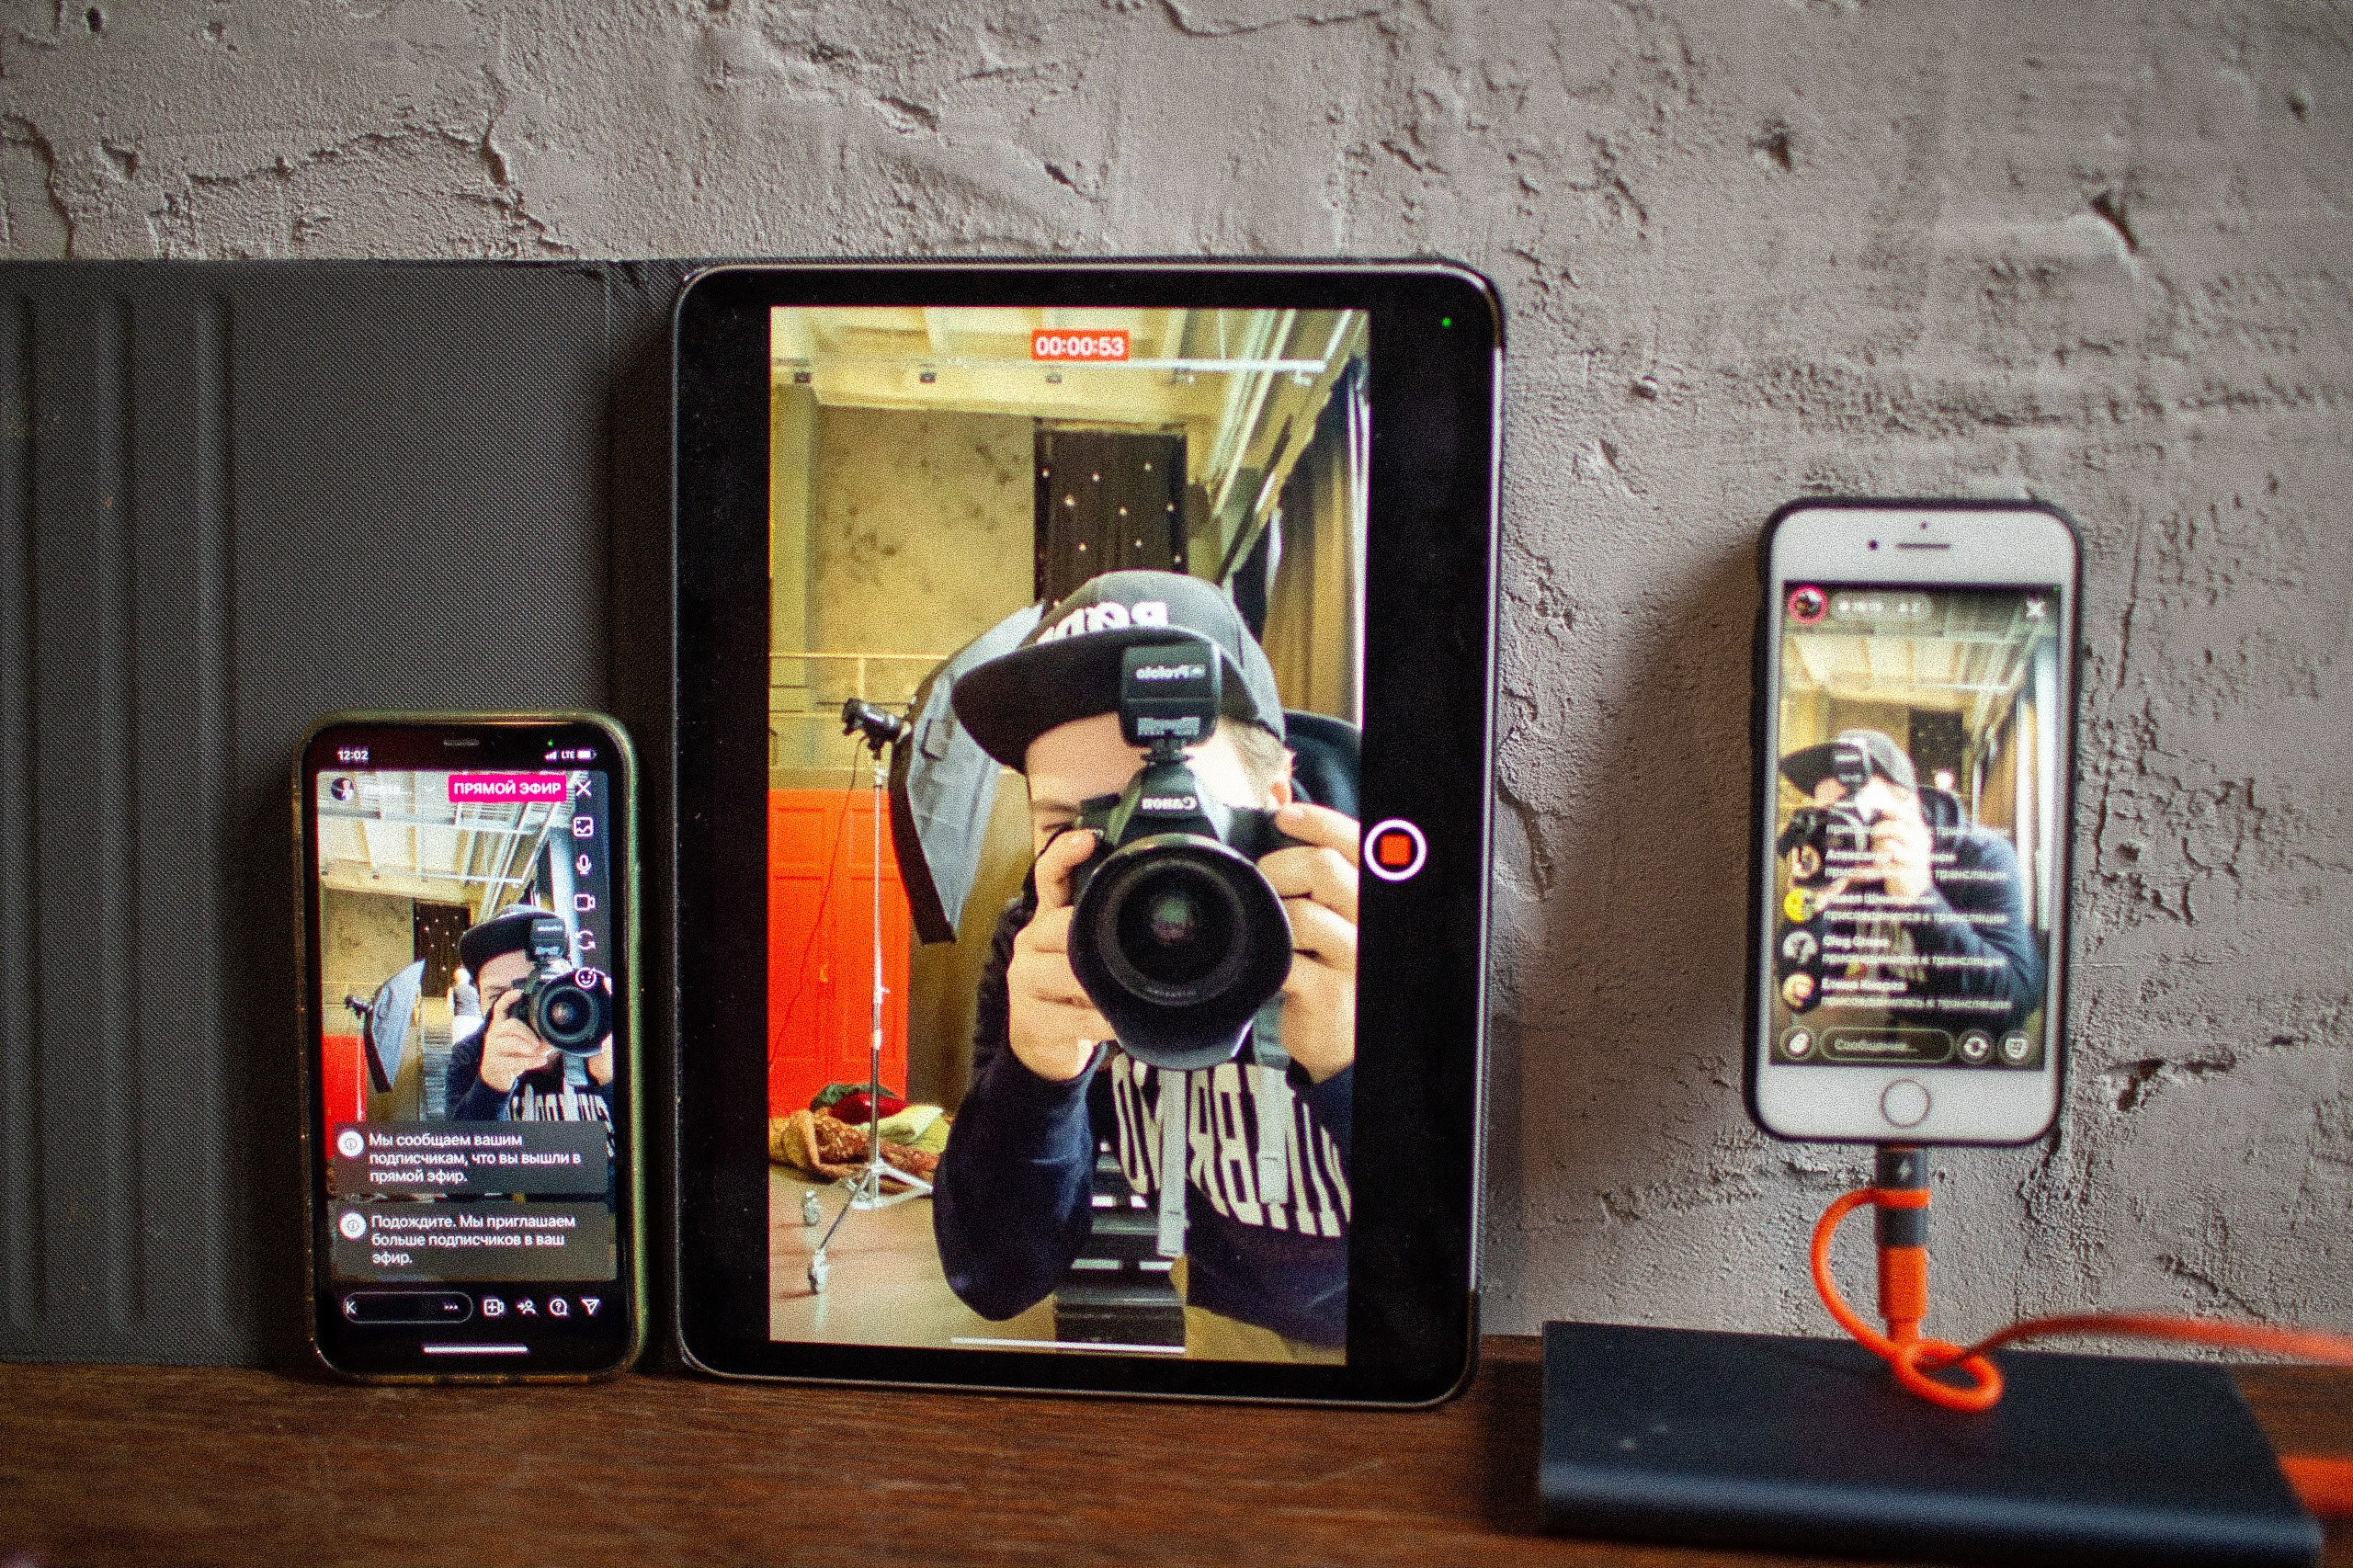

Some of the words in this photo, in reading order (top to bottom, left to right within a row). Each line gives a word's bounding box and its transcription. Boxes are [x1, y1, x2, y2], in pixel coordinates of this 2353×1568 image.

[1035, 336, 1124, 357] 00:00:53
[337, 750, 369, 761] 12:02
[561, 750, 575, 759] LTE
[453, 779, 517, 795] ПРЯМОЙ
[518, 782, 562, 795] ЭФИР
[369, 1134, 392, 1146] Мы
[397, 1132, 471, 1148] сообщаем
[474, 1135, 522, 1146] вашим
[369, 1153, 468, 1166] подписчикам,
[472, 1153, 495, 1165] что
[499, 1153, 518, 1165] вы
[522, 1153, 569, 1165] вышли
[572, 1154, 581, 1165] в
[370, 1168, 424, 1184] прямой
[426, 1169, 467, 1185] эфир.
[371, 1216, 456, 1230] Подождите.
[460, 1216, 483, 1227] Мы
[487, 1217, 575, 1230] приглашаем
[371, 1233, 426, 1246] больше
[429, 1235, 521, 1248] подписчиков
[525, 1236, 533, 1246] в
[537, 1235, 564, 1246] ваш
[372, 1253, 413, 1267] эфир.
